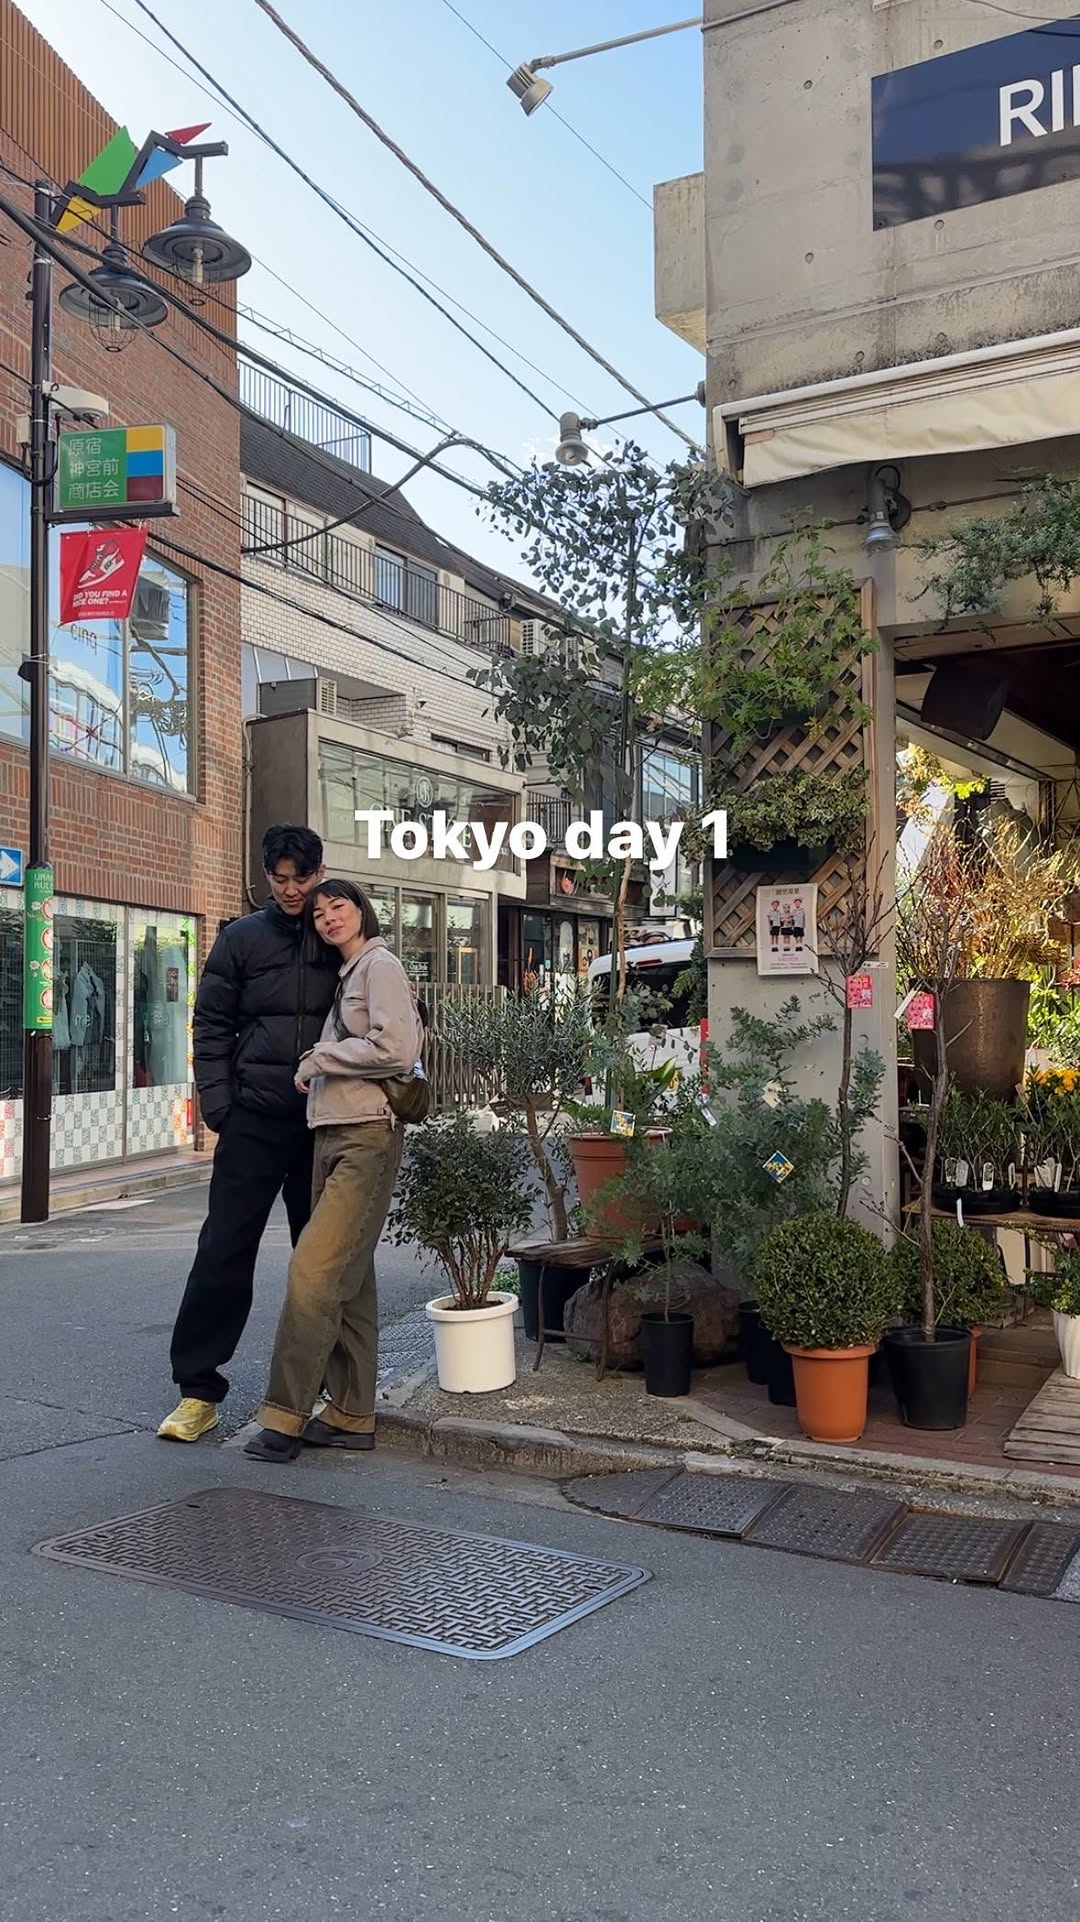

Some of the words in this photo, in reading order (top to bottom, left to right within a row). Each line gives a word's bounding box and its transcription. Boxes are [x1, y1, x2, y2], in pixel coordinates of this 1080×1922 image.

[998, 65, 1080, 147] RI
[68, 437, 102, 457] 原宿
[68, 457, 119, 479] 神宮前
[68, 479, 119, 501] 商店会
[84, 590, 101, 599] YOU
[121, 589, 128, 598] A
[87, 597, 109, 605] ONE?
